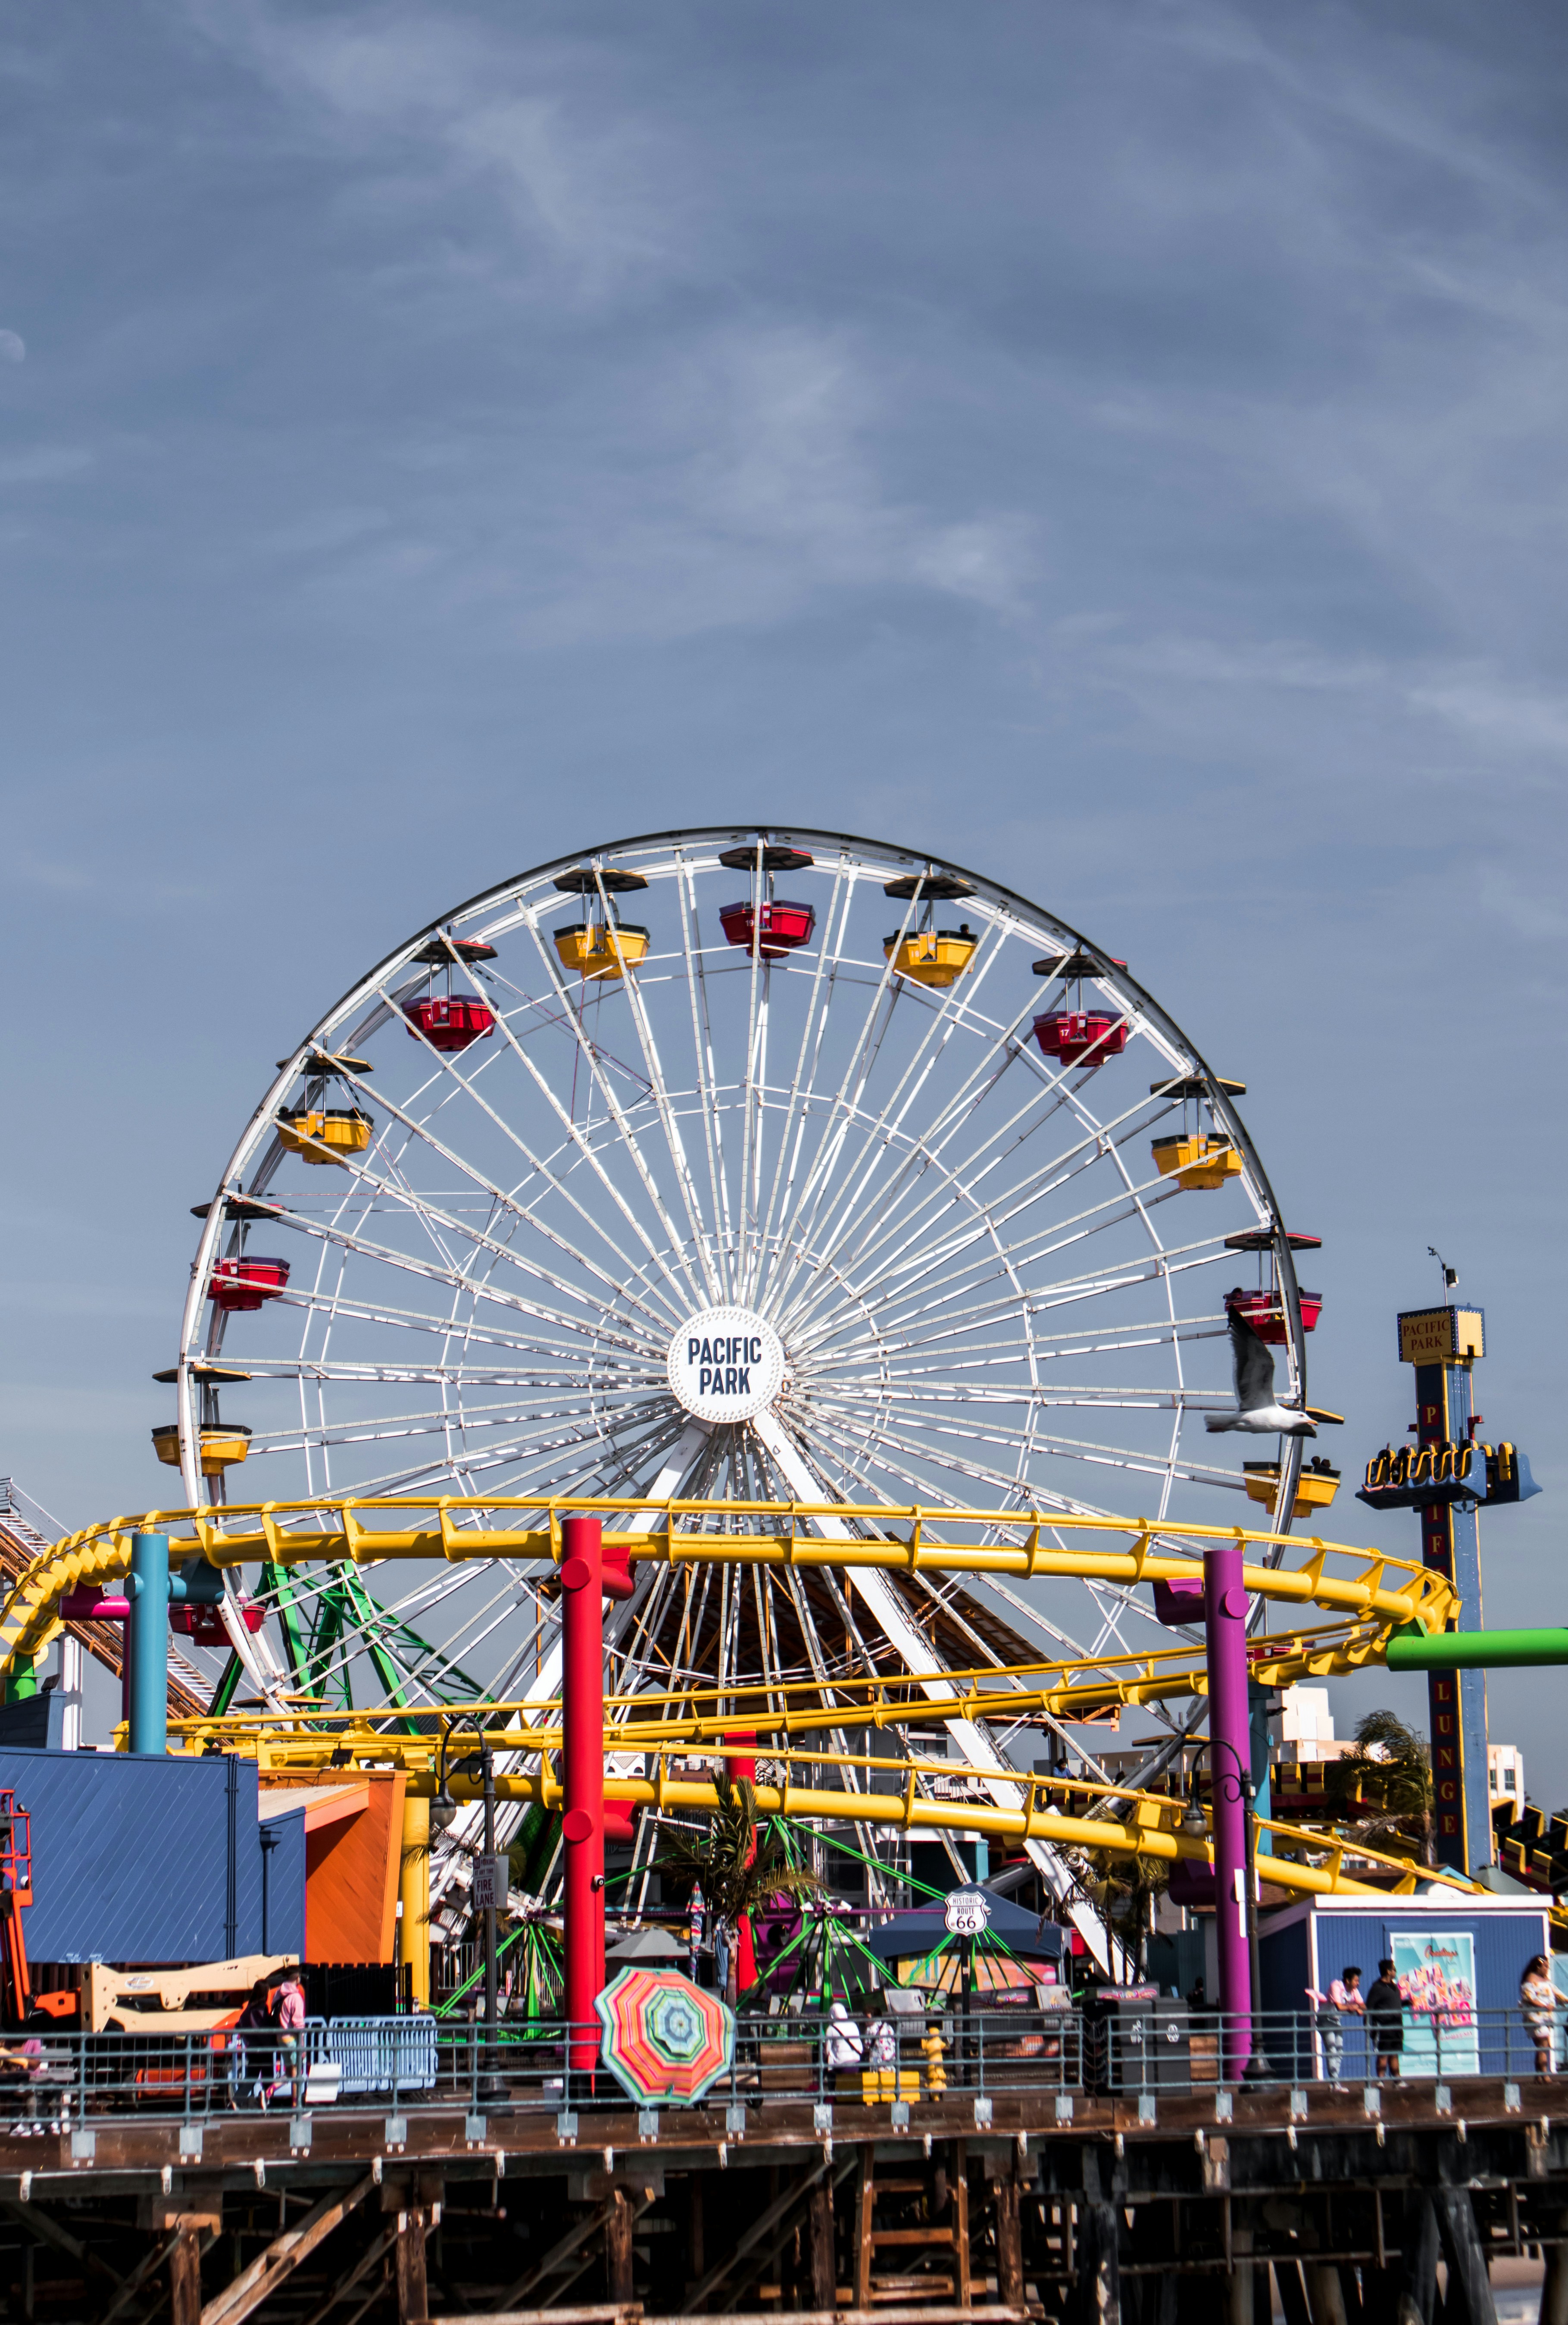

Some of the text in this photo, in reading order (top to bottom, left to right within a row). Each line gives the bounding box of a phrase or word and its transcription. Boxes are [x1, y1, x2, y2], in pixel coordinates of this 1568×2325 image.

[1403, 1319, 1449, 1337] PACIFIC
[688, 1337, 762, 1365] PACIFIC
[1411, 1336, 1443, 1351] PARK
[700, 1367, 750, 1395] PARK
[1437, 1683, 1455, 1834] LUNGE
[474, 1858, 494, 1868] NO PKING
[477, 1879, 492, 1892] FIRE
[476, 1892, 494, 1906] LANE
[956, 1916, 976, 1929] 66
